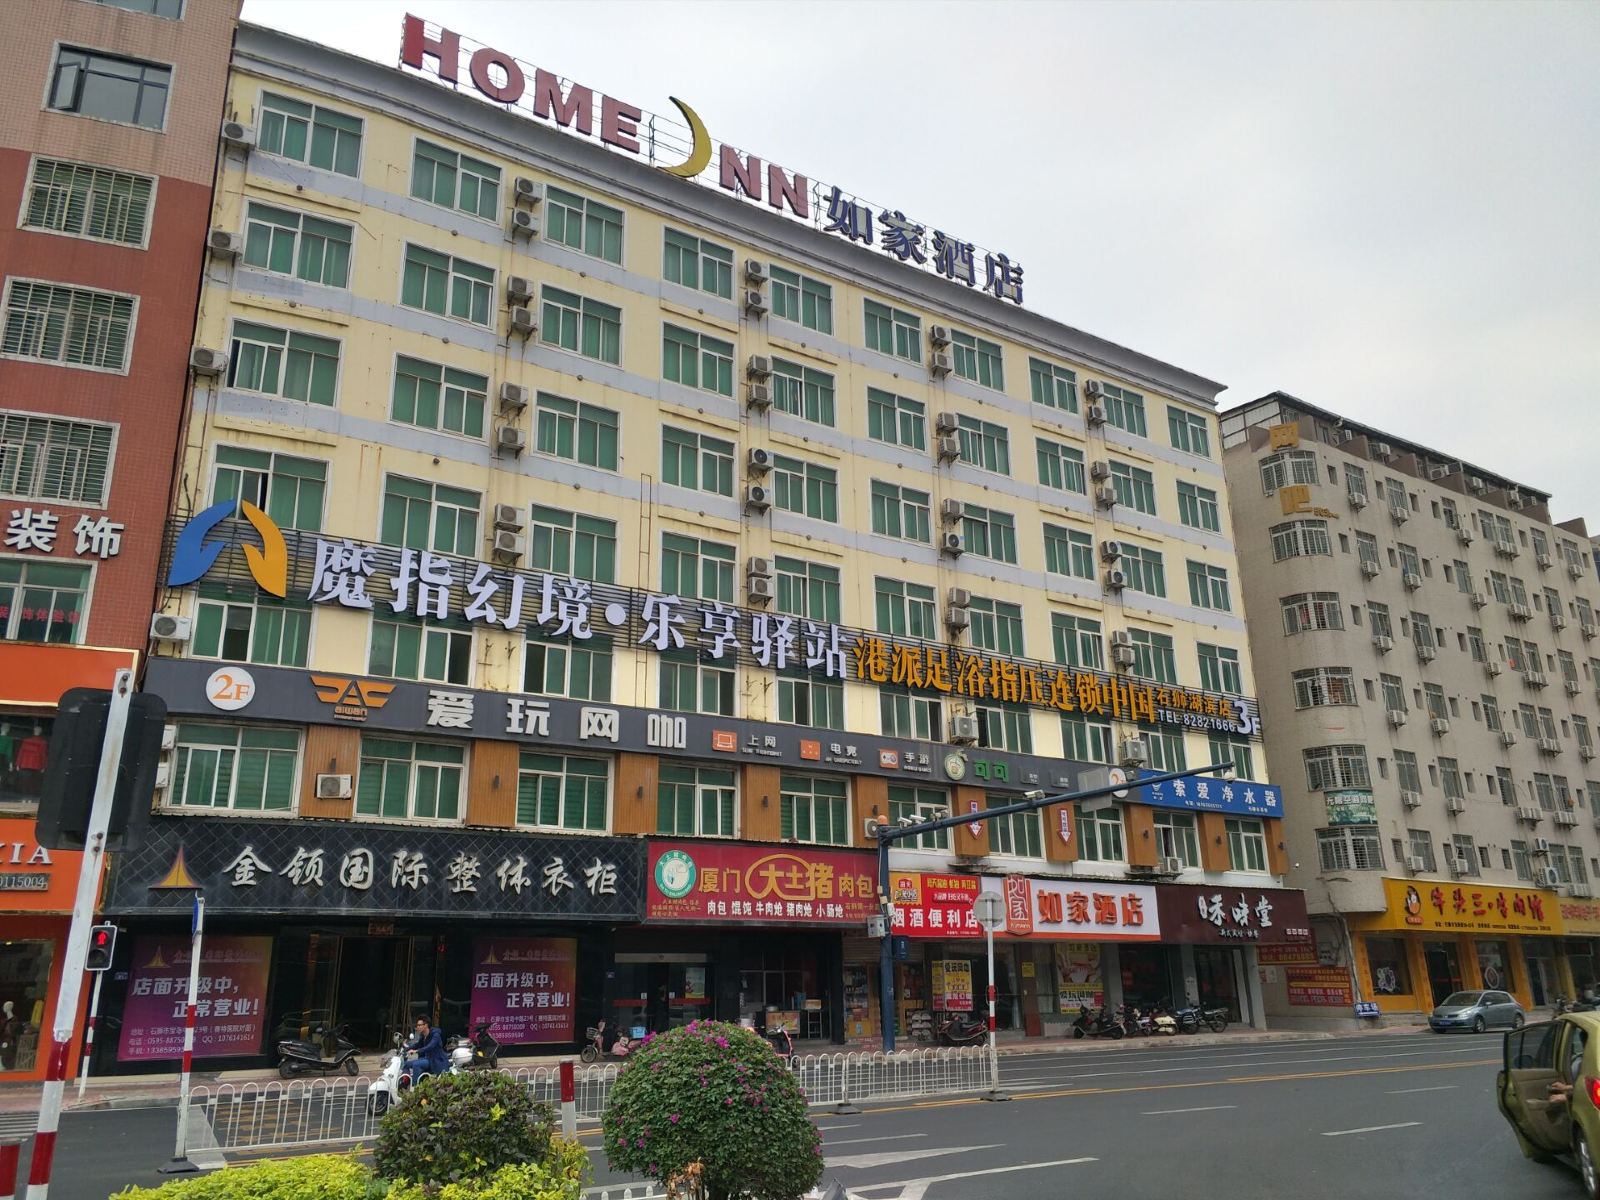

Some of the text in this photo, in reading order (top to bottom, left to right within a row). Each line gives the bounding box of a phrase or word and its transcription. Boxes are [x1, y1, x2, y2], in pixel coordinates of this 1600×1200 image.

[401, 12, 642, 155] HOME
[822, 185, 1024, 305] 如家酒店
[3, 508, 124, 559] 装饰
[212, 674, 250, 701] 2F
[426, 689, 687, 749] 爱玩网咖
[1233, 699, 1260, 735] 3F
[747, 734, 778, 749] 上网
[830, 742, 858, 758] 电竞
[903, 751, 930, 766] 手游
[972, 759, 1009, 783] 可可
[1172, 778, 1277, 807] 索爱净水器
[221, 845, 619, 896] 金领国际整体衣柜
[698, 867, 741, 894] 厦门
[837, 873, 875, 898] 肉包
[706, 900, 727, 916] 肉包
[891, 907, 979, 929] 烟酒便利店
[1037, 890, 1145, 927] 如家酒店
